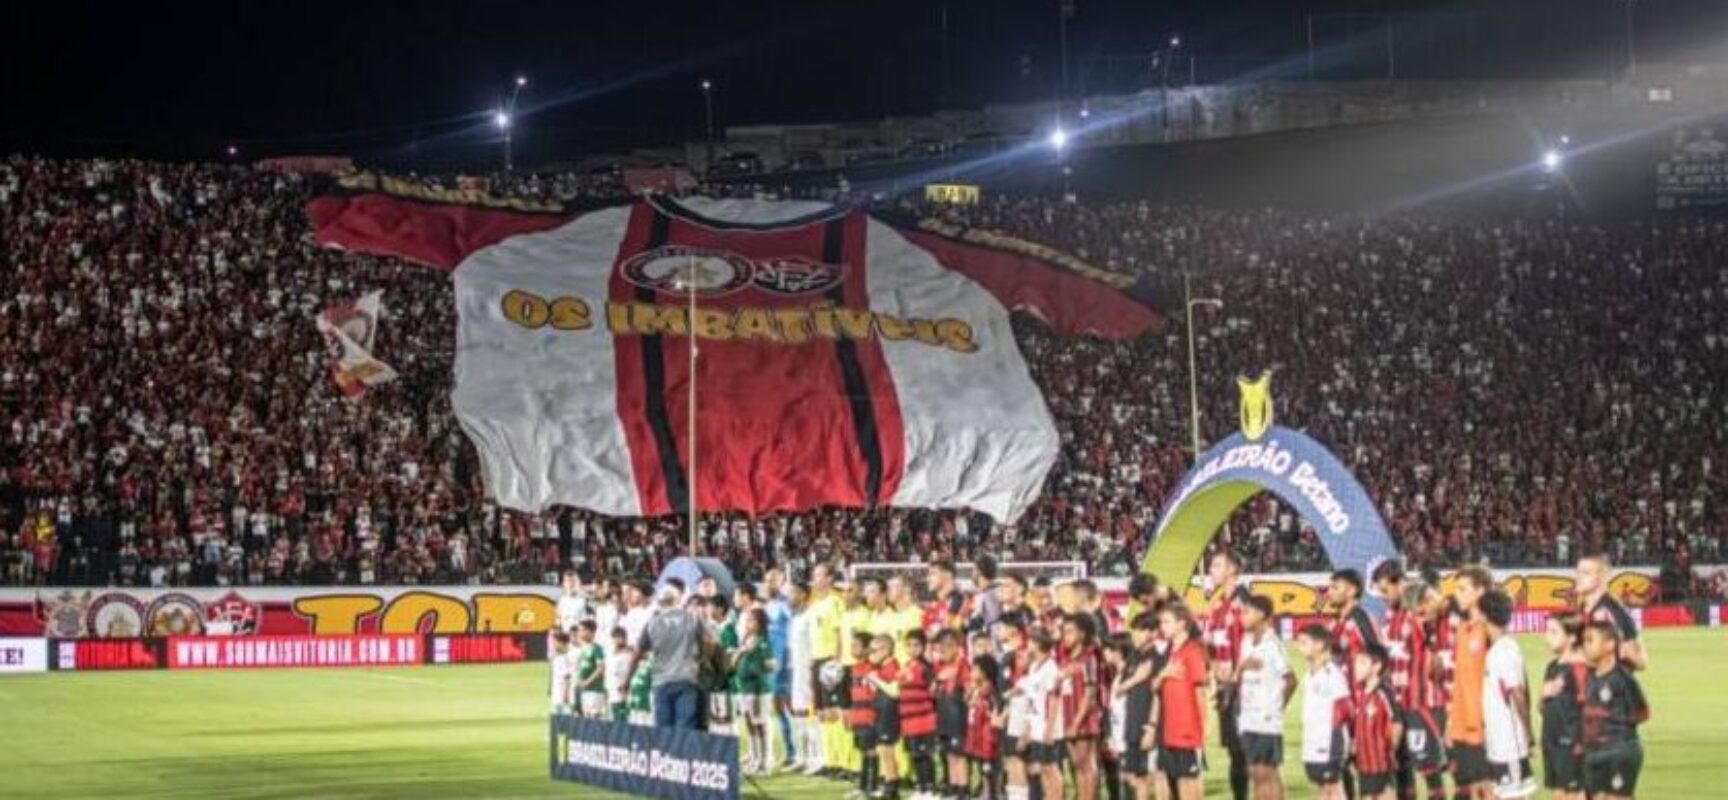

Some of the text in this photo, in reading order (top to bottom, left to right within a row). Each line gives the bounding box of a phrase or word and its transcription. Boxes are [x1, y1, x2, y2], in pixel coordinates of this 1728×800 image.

[501, 288, 592, 330] OS
[1289, 461, 1350, 534] Betano
[567, 738, 730, 790] BRASILEIRÃO Betano 2025
